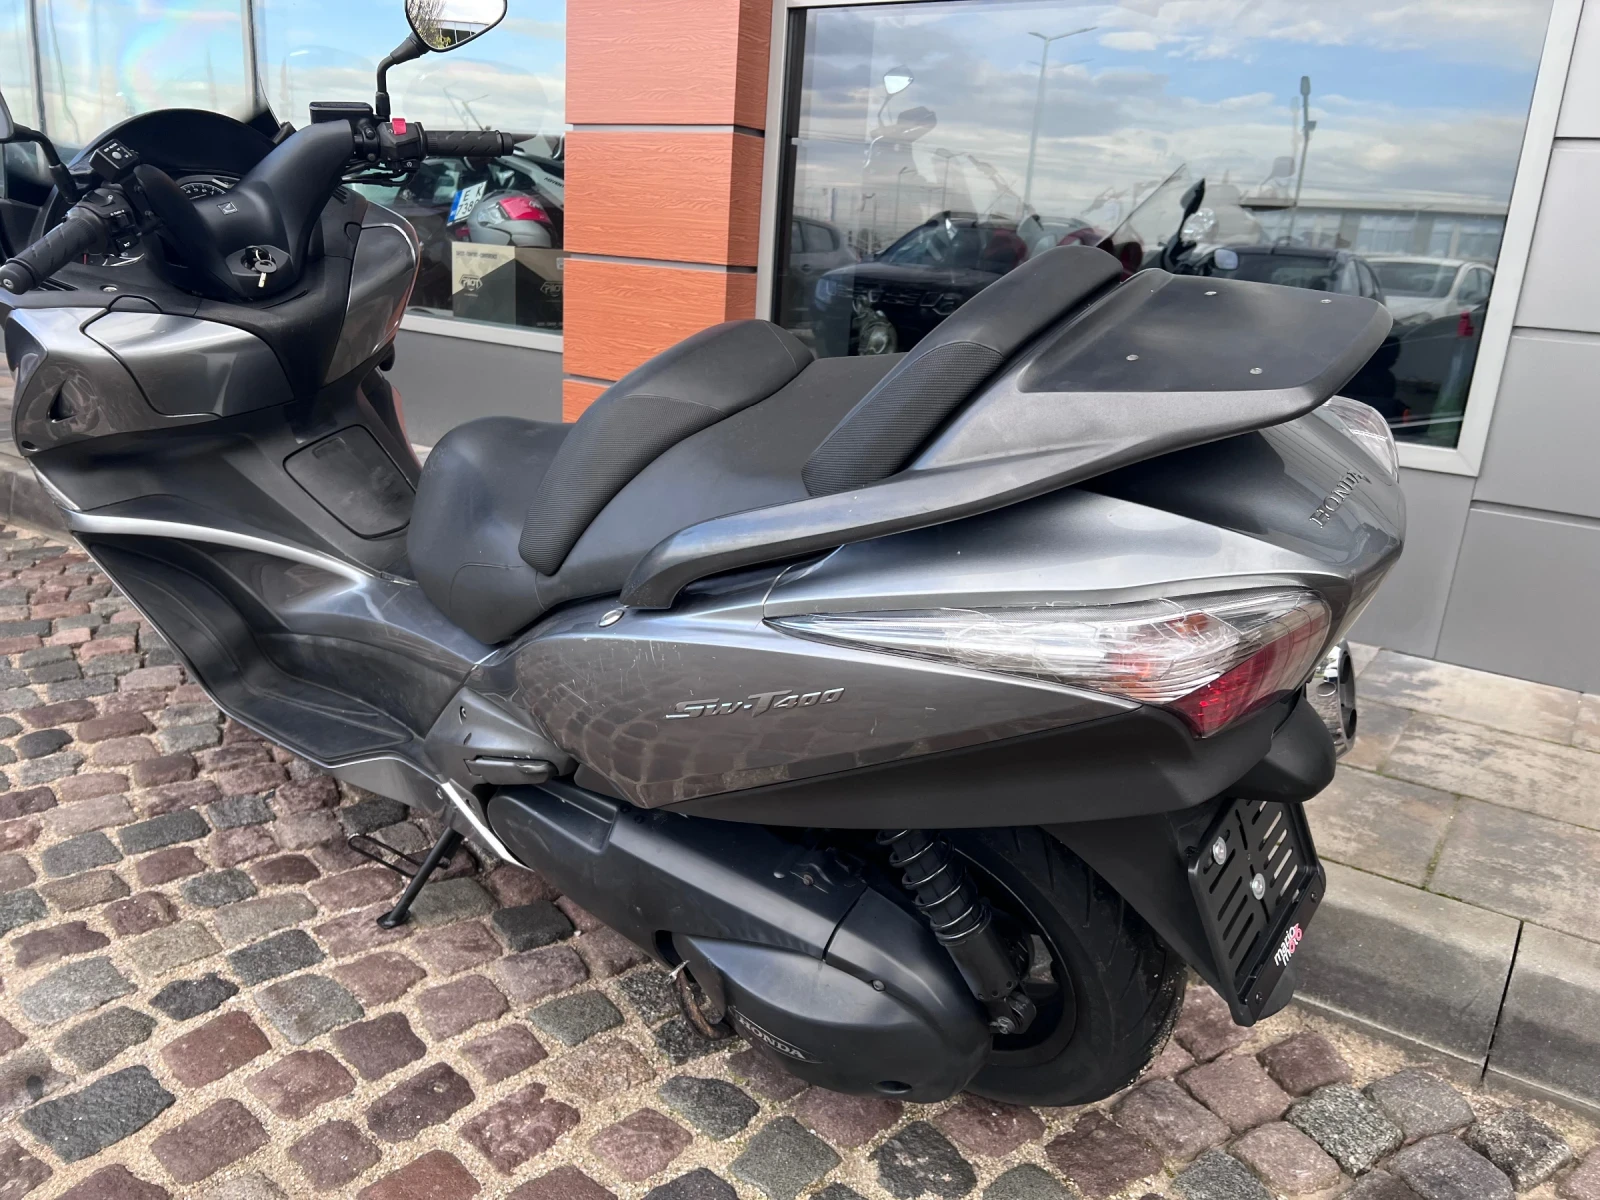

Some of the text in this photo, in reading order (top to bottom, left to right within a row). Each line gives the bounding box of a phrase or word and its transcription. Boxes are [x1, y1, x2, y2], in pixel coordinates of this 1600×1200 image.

[463, 186, 483, 202] E K
[1308, 470, 1373, 530] HONDA
[1273, 926, 1297, 967] mario
[1281, 926, 1303, 967] moto
[738, 1016, 807, 1060] HONDA
